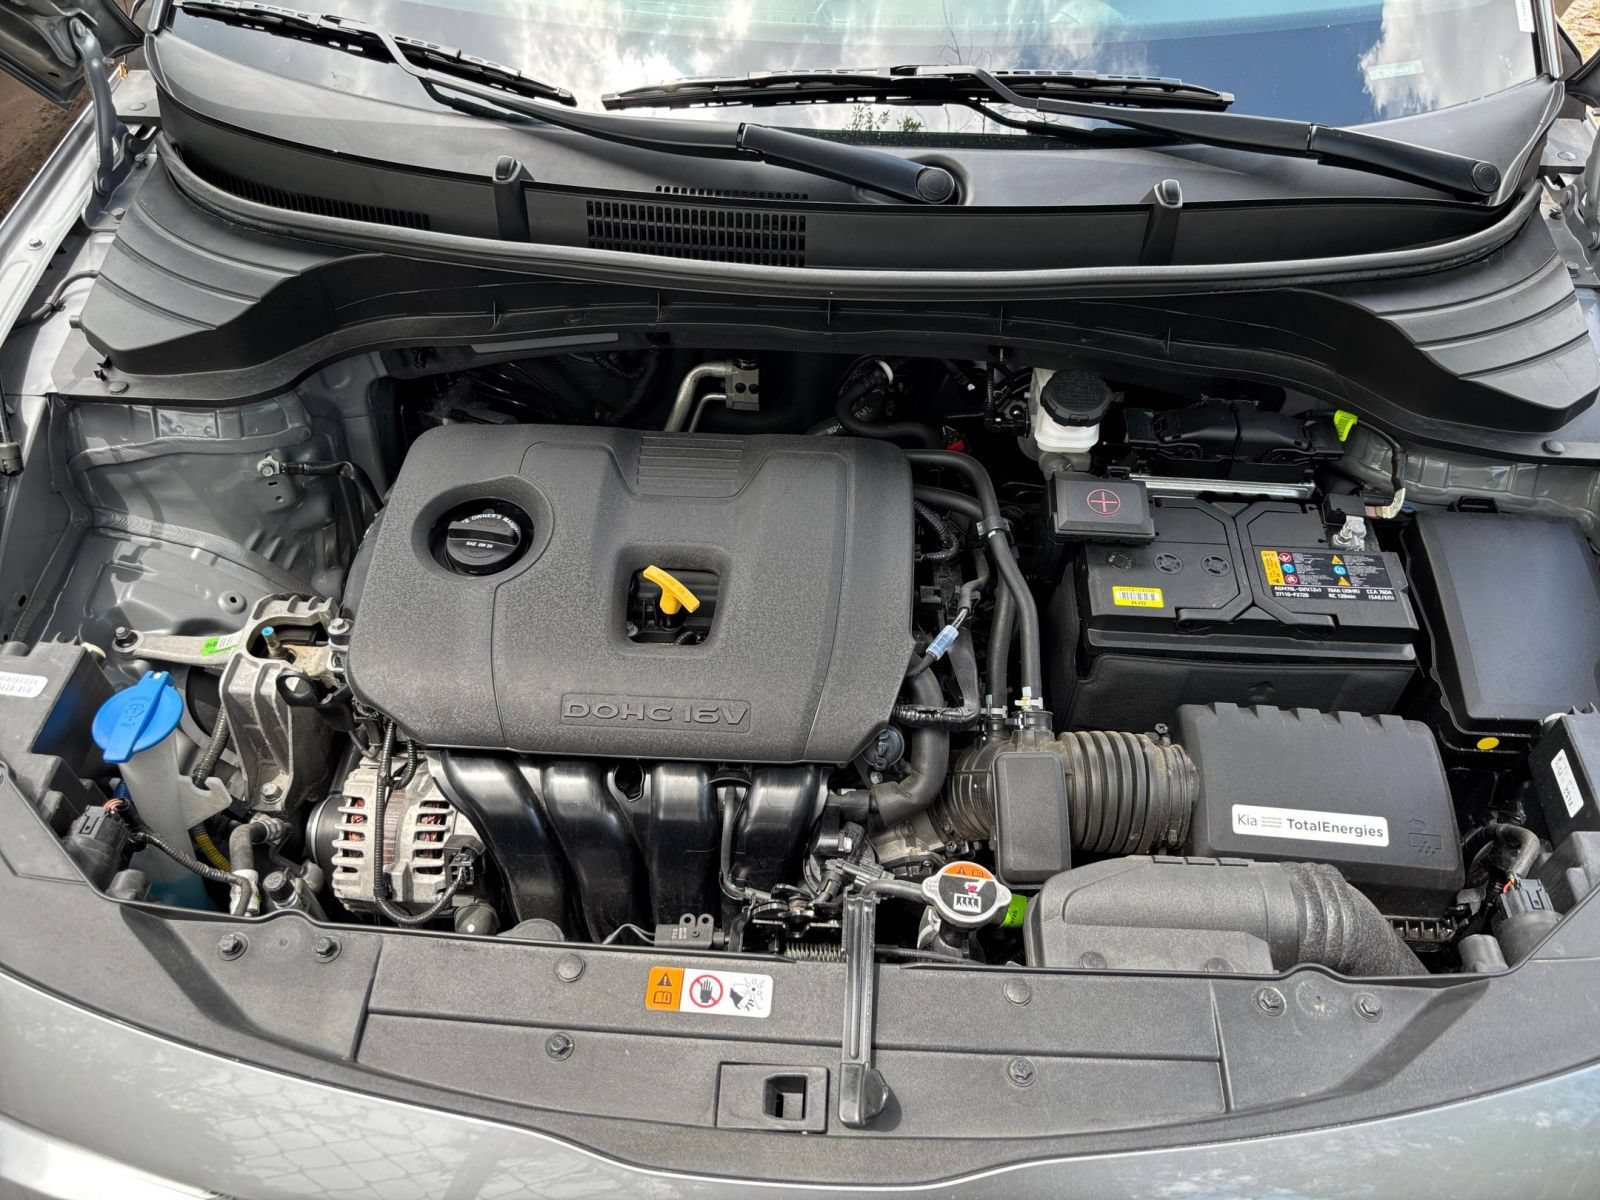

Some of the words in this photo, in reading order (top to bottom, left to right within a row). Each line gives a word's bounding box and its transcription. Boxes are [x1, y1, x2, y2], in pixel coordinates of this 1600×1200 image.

[564, 703, 673, 722] DOHC
[684, 705, 748, 725] 16V
[1237, 813, 1258, 826] Kia
[1286, 817, 1384, 838] TotalEnergies
